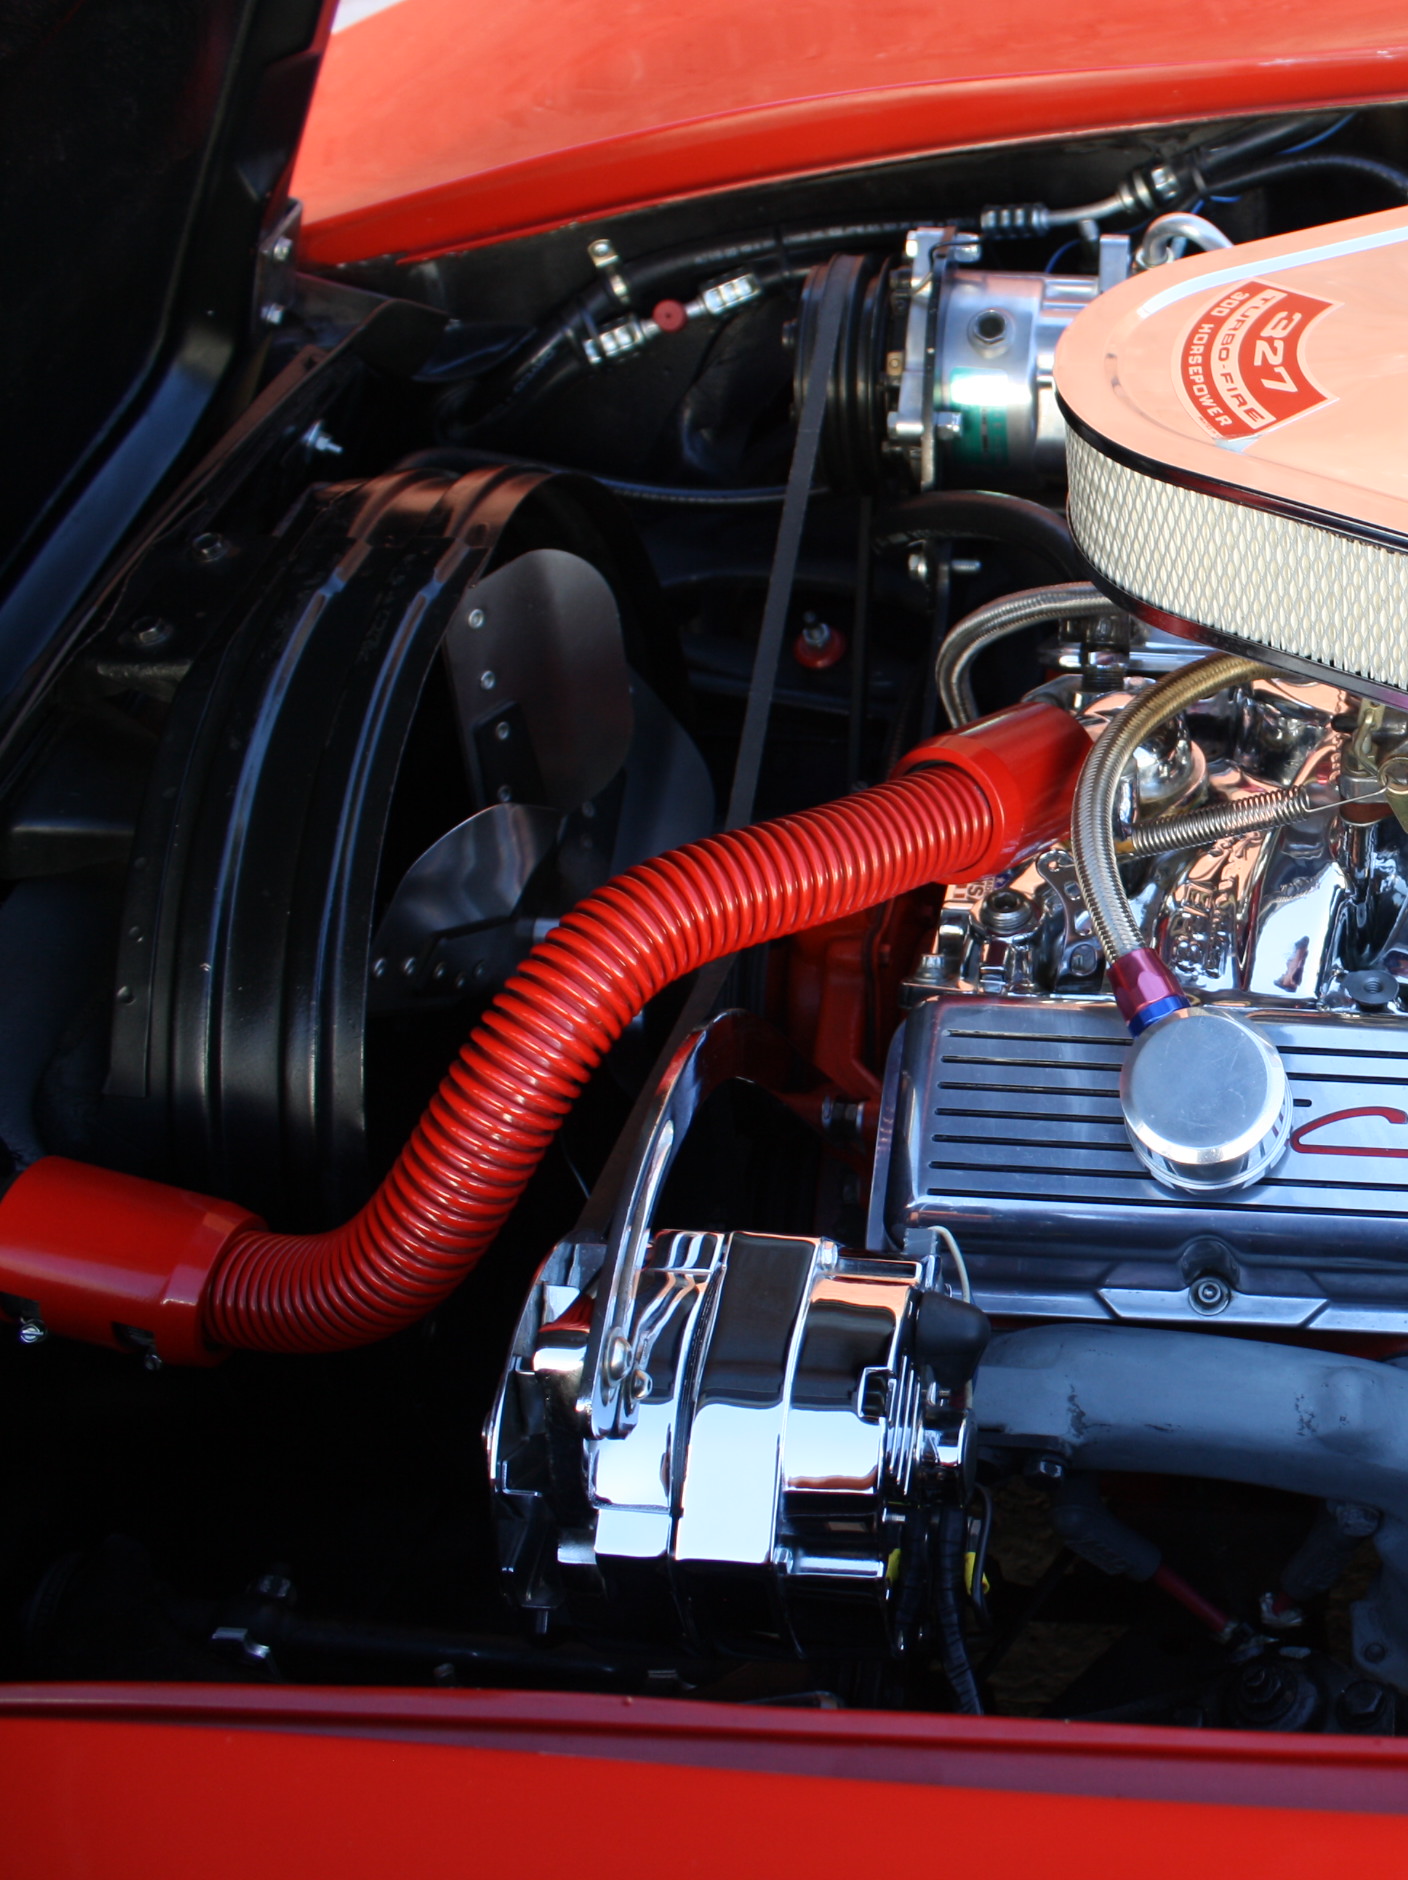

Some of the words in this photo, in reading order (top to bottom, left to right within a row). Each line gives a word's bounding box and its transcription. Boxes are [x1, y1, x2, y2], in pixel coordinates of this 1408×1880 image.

[1210, 291, 1250, 317] 300
[1188, 323, 1233, 427] HORSEPOWER
[1218, 295, 1276, 423] TURBO-FIRE
[1253, 311, 1302, 393] 327
